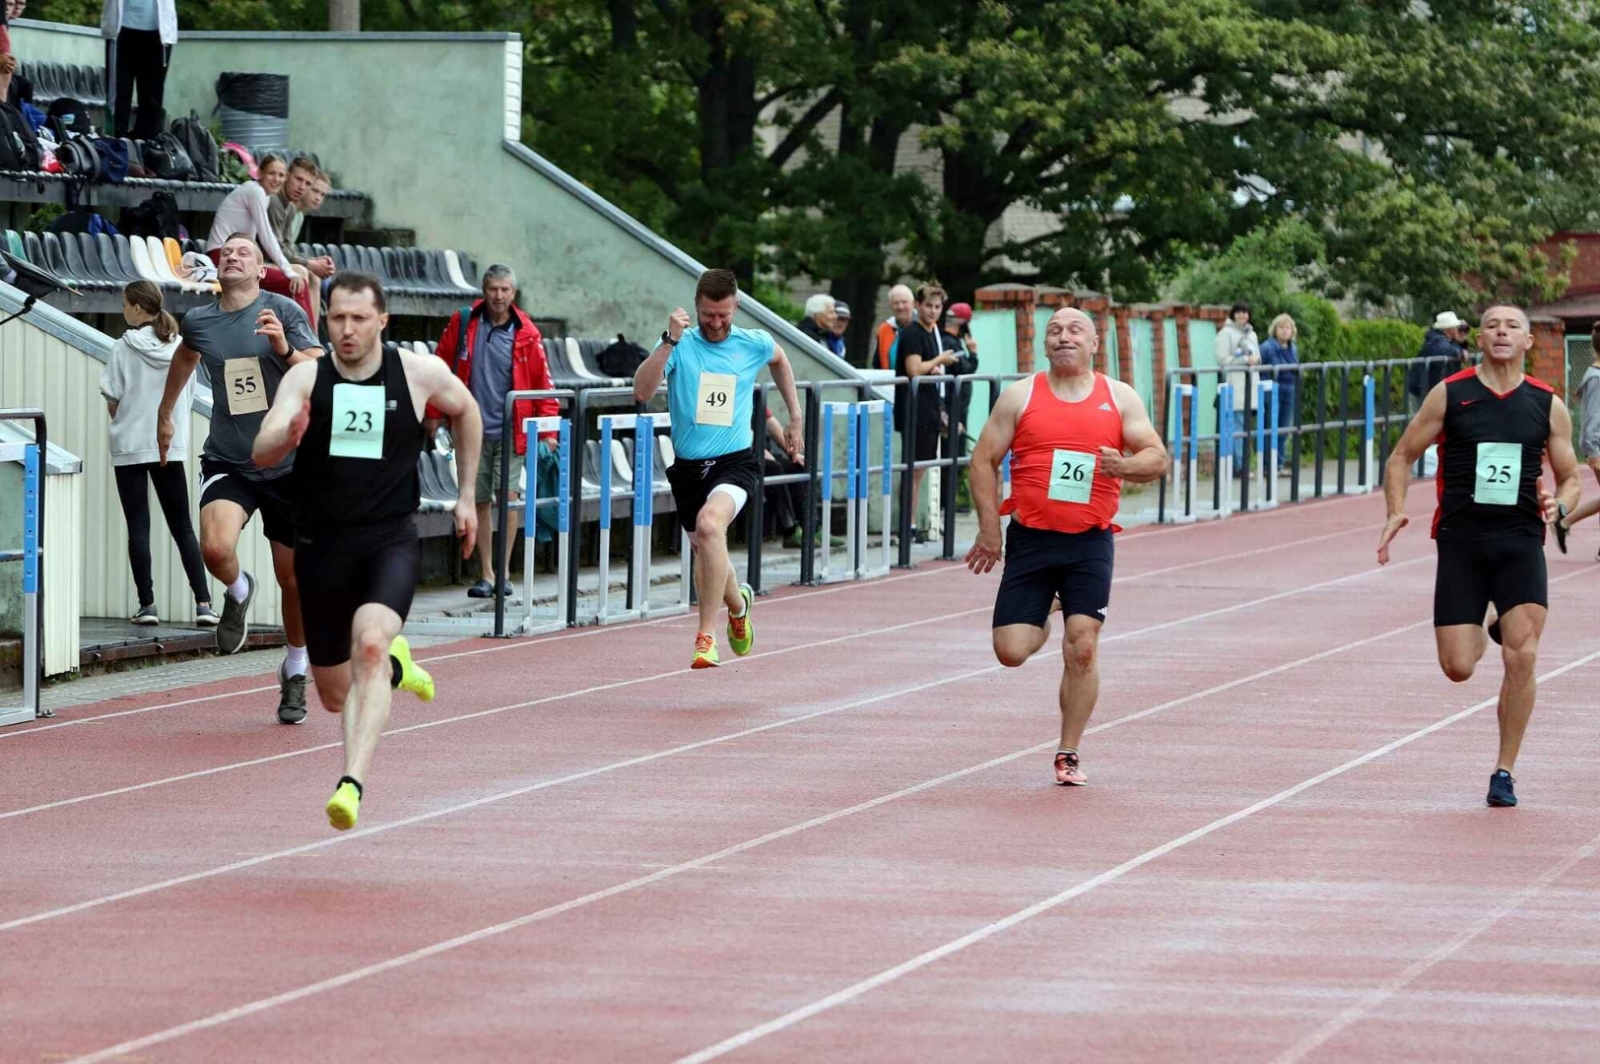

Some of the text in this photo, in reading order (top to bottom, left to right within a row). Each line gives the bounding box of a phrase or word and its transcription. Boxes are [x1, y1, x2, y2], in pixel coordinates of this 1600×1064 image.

[234, 376, 257, 395] 55
[705, 391, 727, 407] 49
[344, 410, 373, 433] 23
[1060, 461, 1085, 482] 26
[1486, 464, 1511, 484] 25
